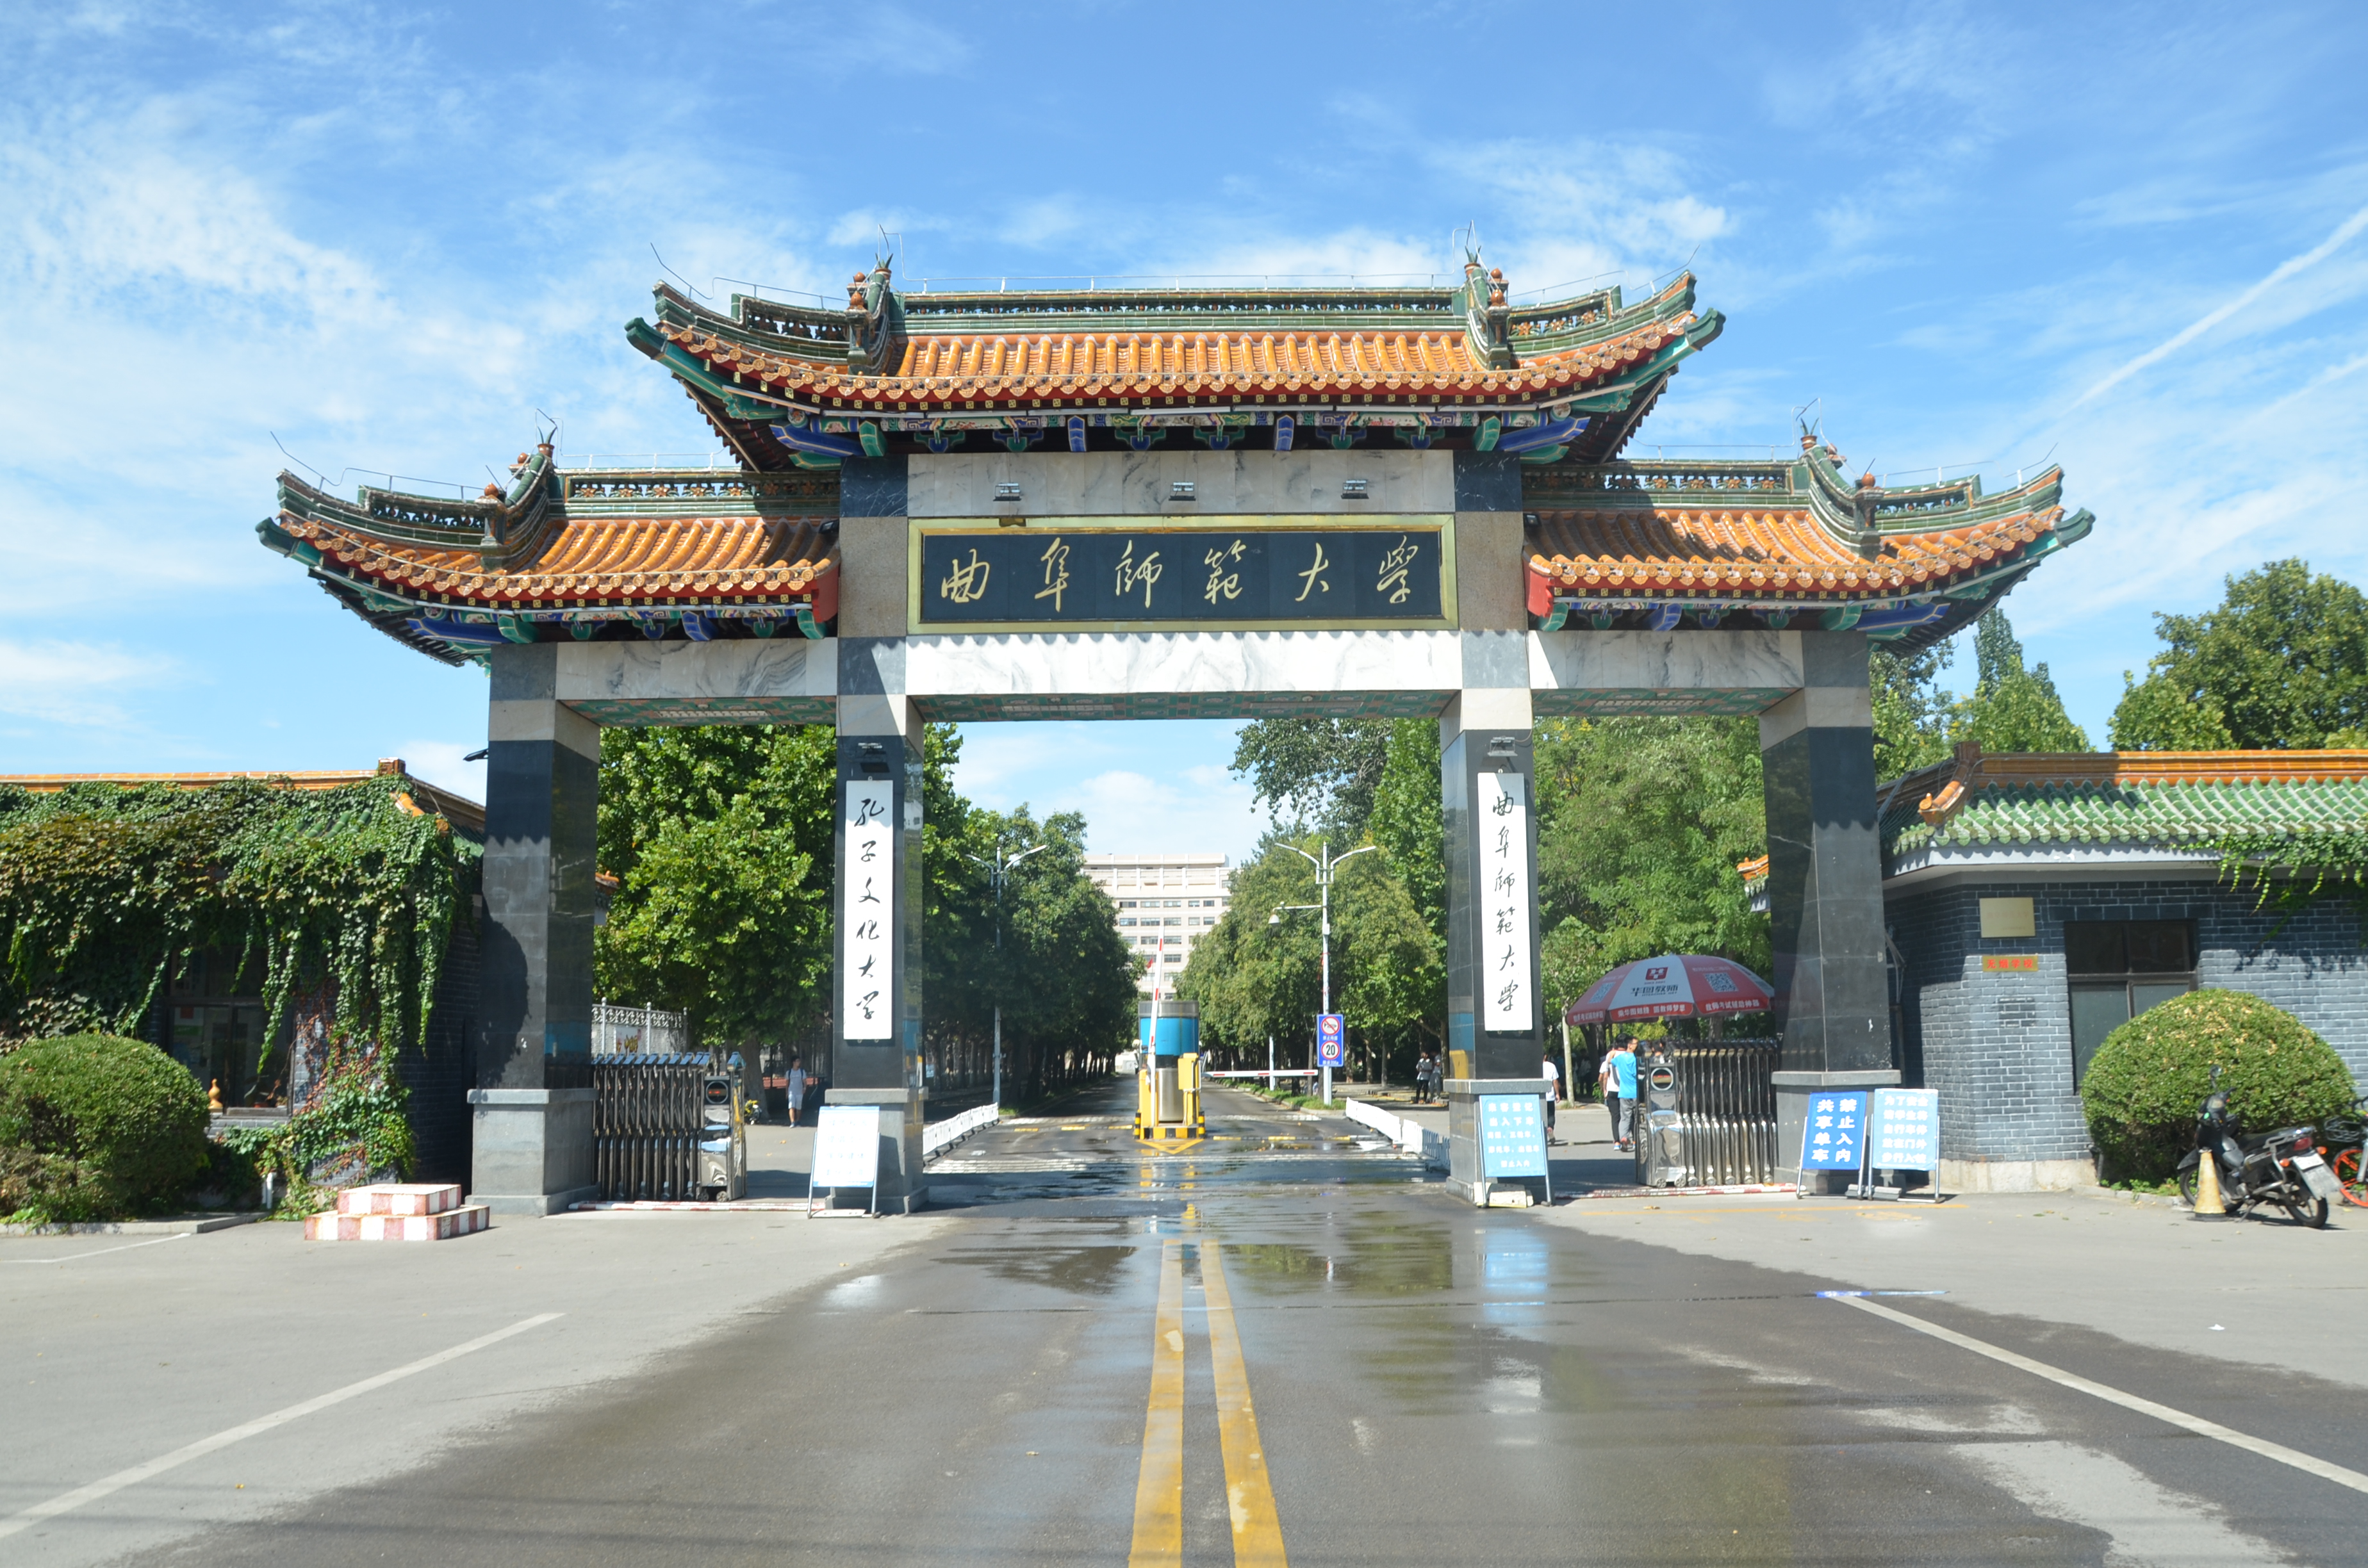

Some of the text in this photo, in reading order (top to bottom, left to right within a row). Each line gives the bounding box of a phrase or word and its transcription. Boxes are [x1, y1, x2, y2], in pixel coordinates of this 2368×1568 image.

[1987, 958, 2033, 968] 无烟学校
[1631, 984, 1679, 997] 华图教师
[1705, 999, 1759, 1011] 教师考试辅助神器
[1326, 1044, 1335, 1055] 20
[1884, 1095, 1928, 1107] 为了安全
[1835, 1098, 1857, 1162] 禁止入内
